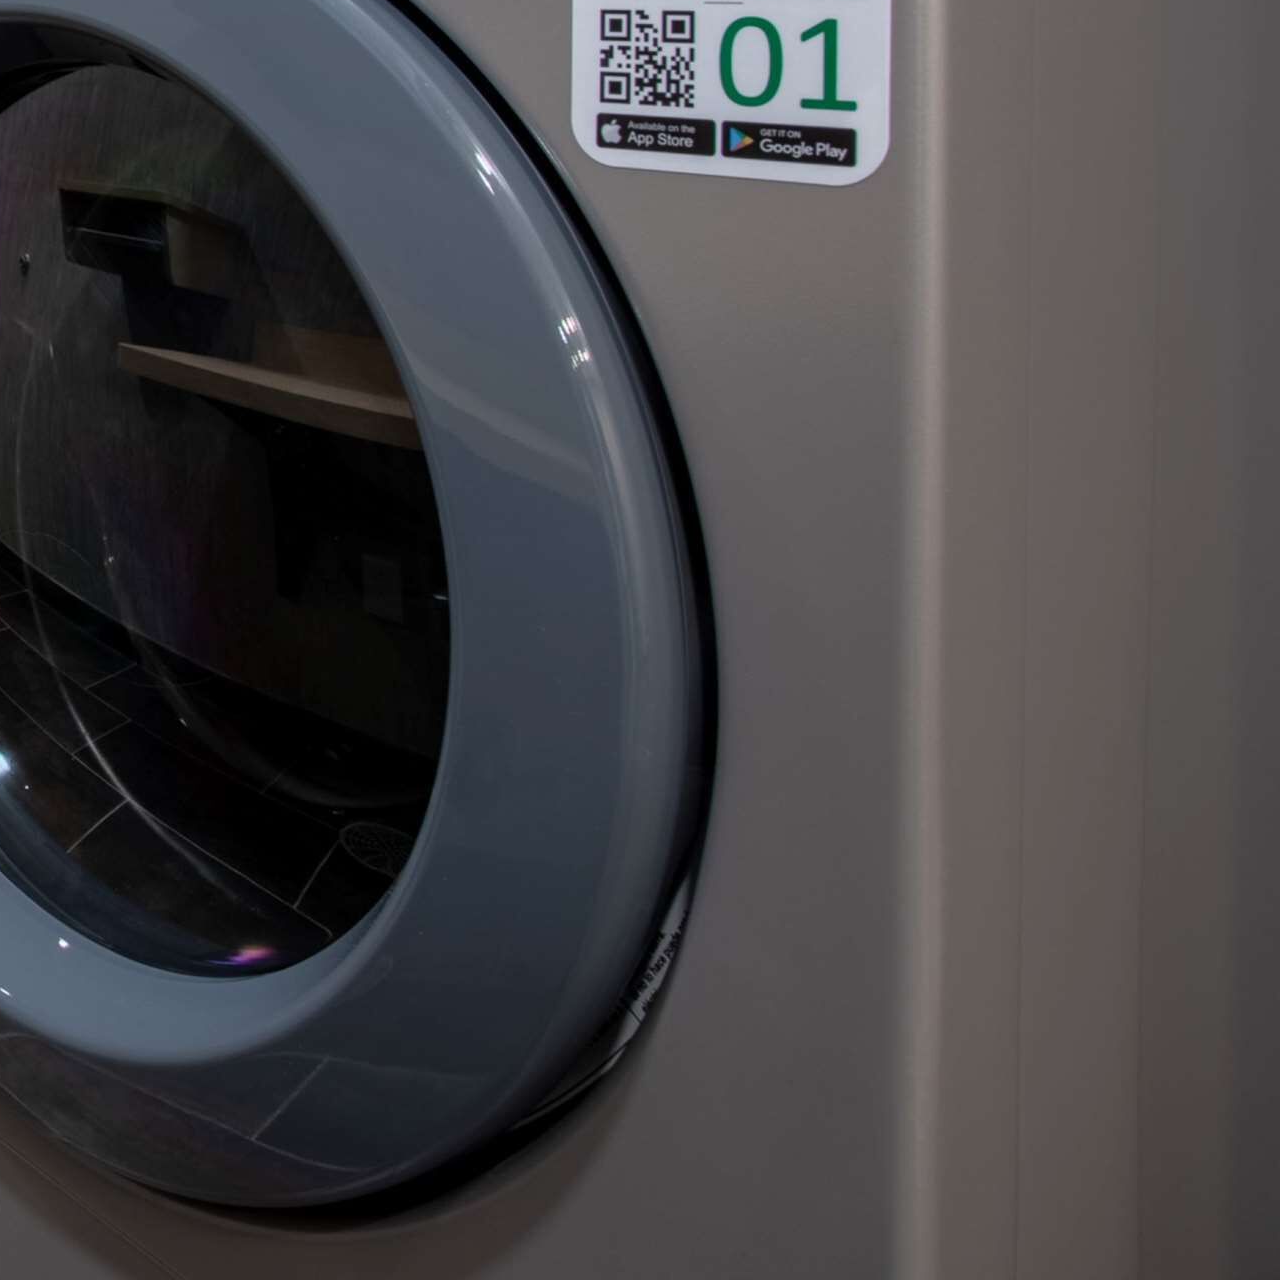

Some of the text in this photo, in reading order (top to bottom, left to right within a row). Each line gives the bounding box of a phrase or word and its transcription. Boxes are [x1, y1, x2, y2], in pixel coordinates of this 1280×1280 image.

[719, 16, 858, 111] 01
[628, 121, 696, 134] Available on the
[760, 128, 801, 139] GET IT ON
[627, 132, 693, 147] App Store
[759, 139, 848, 161] Google Play
